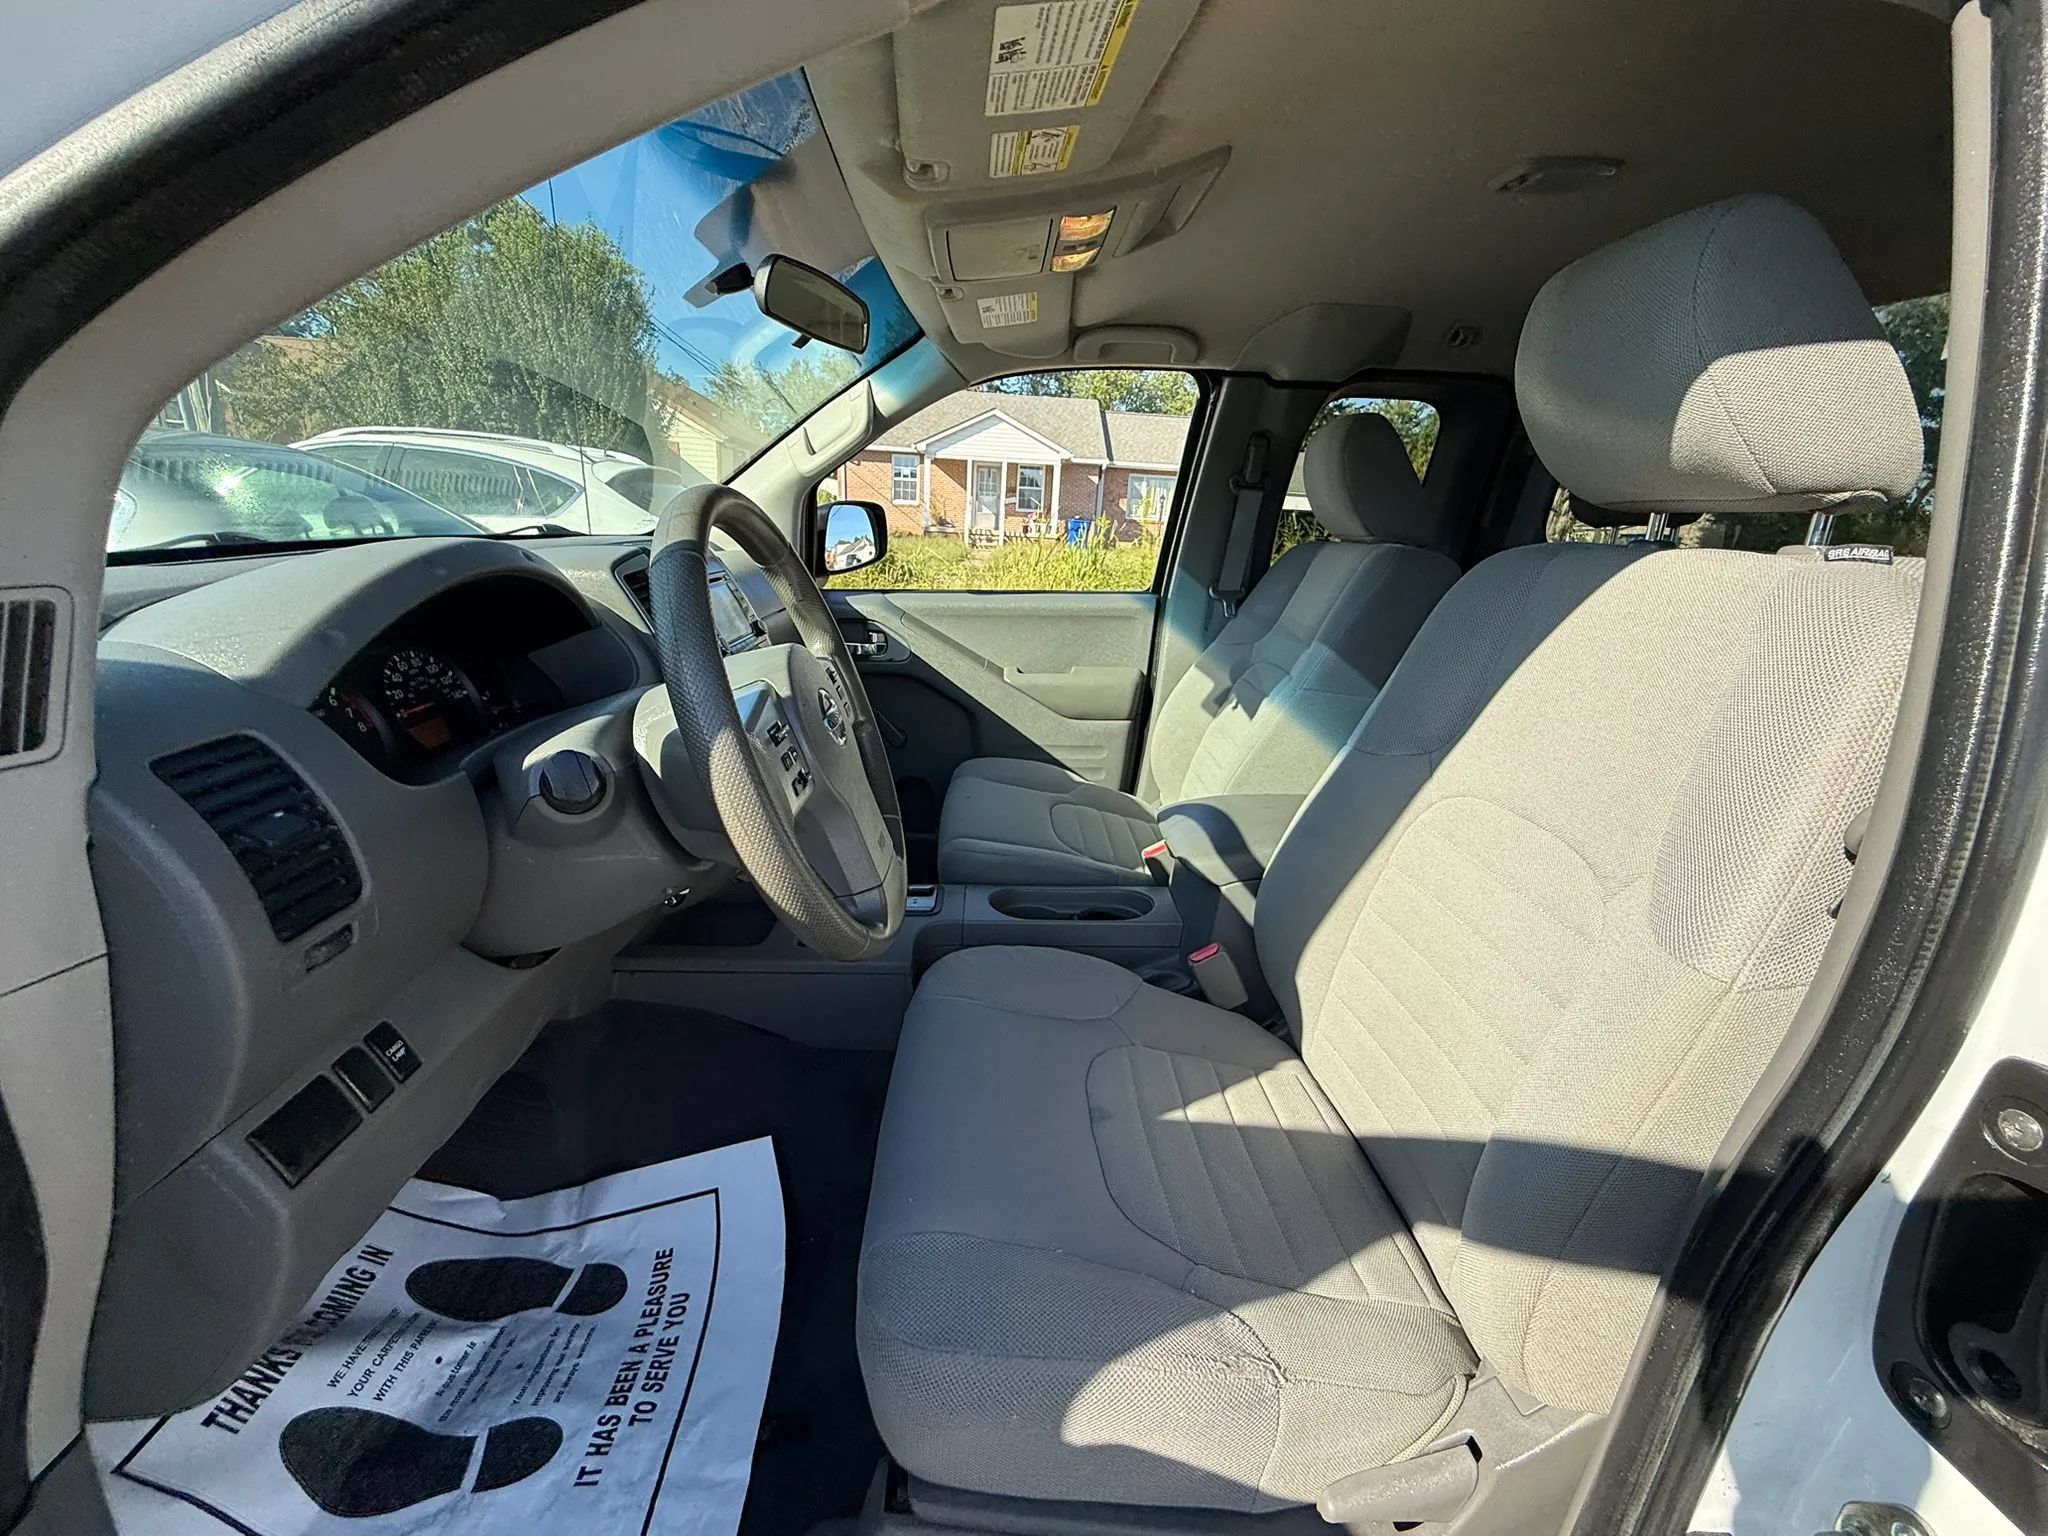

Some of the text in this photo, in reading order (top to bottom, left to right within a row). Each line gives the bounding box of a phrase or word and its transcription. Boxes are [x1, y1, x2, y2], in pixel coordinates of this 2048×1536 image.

[397, 661, 408, 671] 60
[392, 673, 403, 682] 40
[328, 696, 338, 706] 6
[392, 689, 404, 699] 20
[345, 707, 353, 718] 7
[357, 721, 367, 732] 8
[385, 1040, 403, 1057] CARGO
[391, 1047, 406, 1062] LAMP
[200, 1345, 304, 1435] THANKS
[357, 1244, 394, 1267] IN
[326, 1341, 368, 1388] WE HAVE
[573, 1247, 674, 1487] IT HAS BEEN A PLEASURE
[628, 1292, 690, 1427] TO SERVE YOU
[346, 1367, 376, 1398] YOUR
[372, 1374, 398, 1402] WITH
[393, 1351, 414, 1373] THIS
